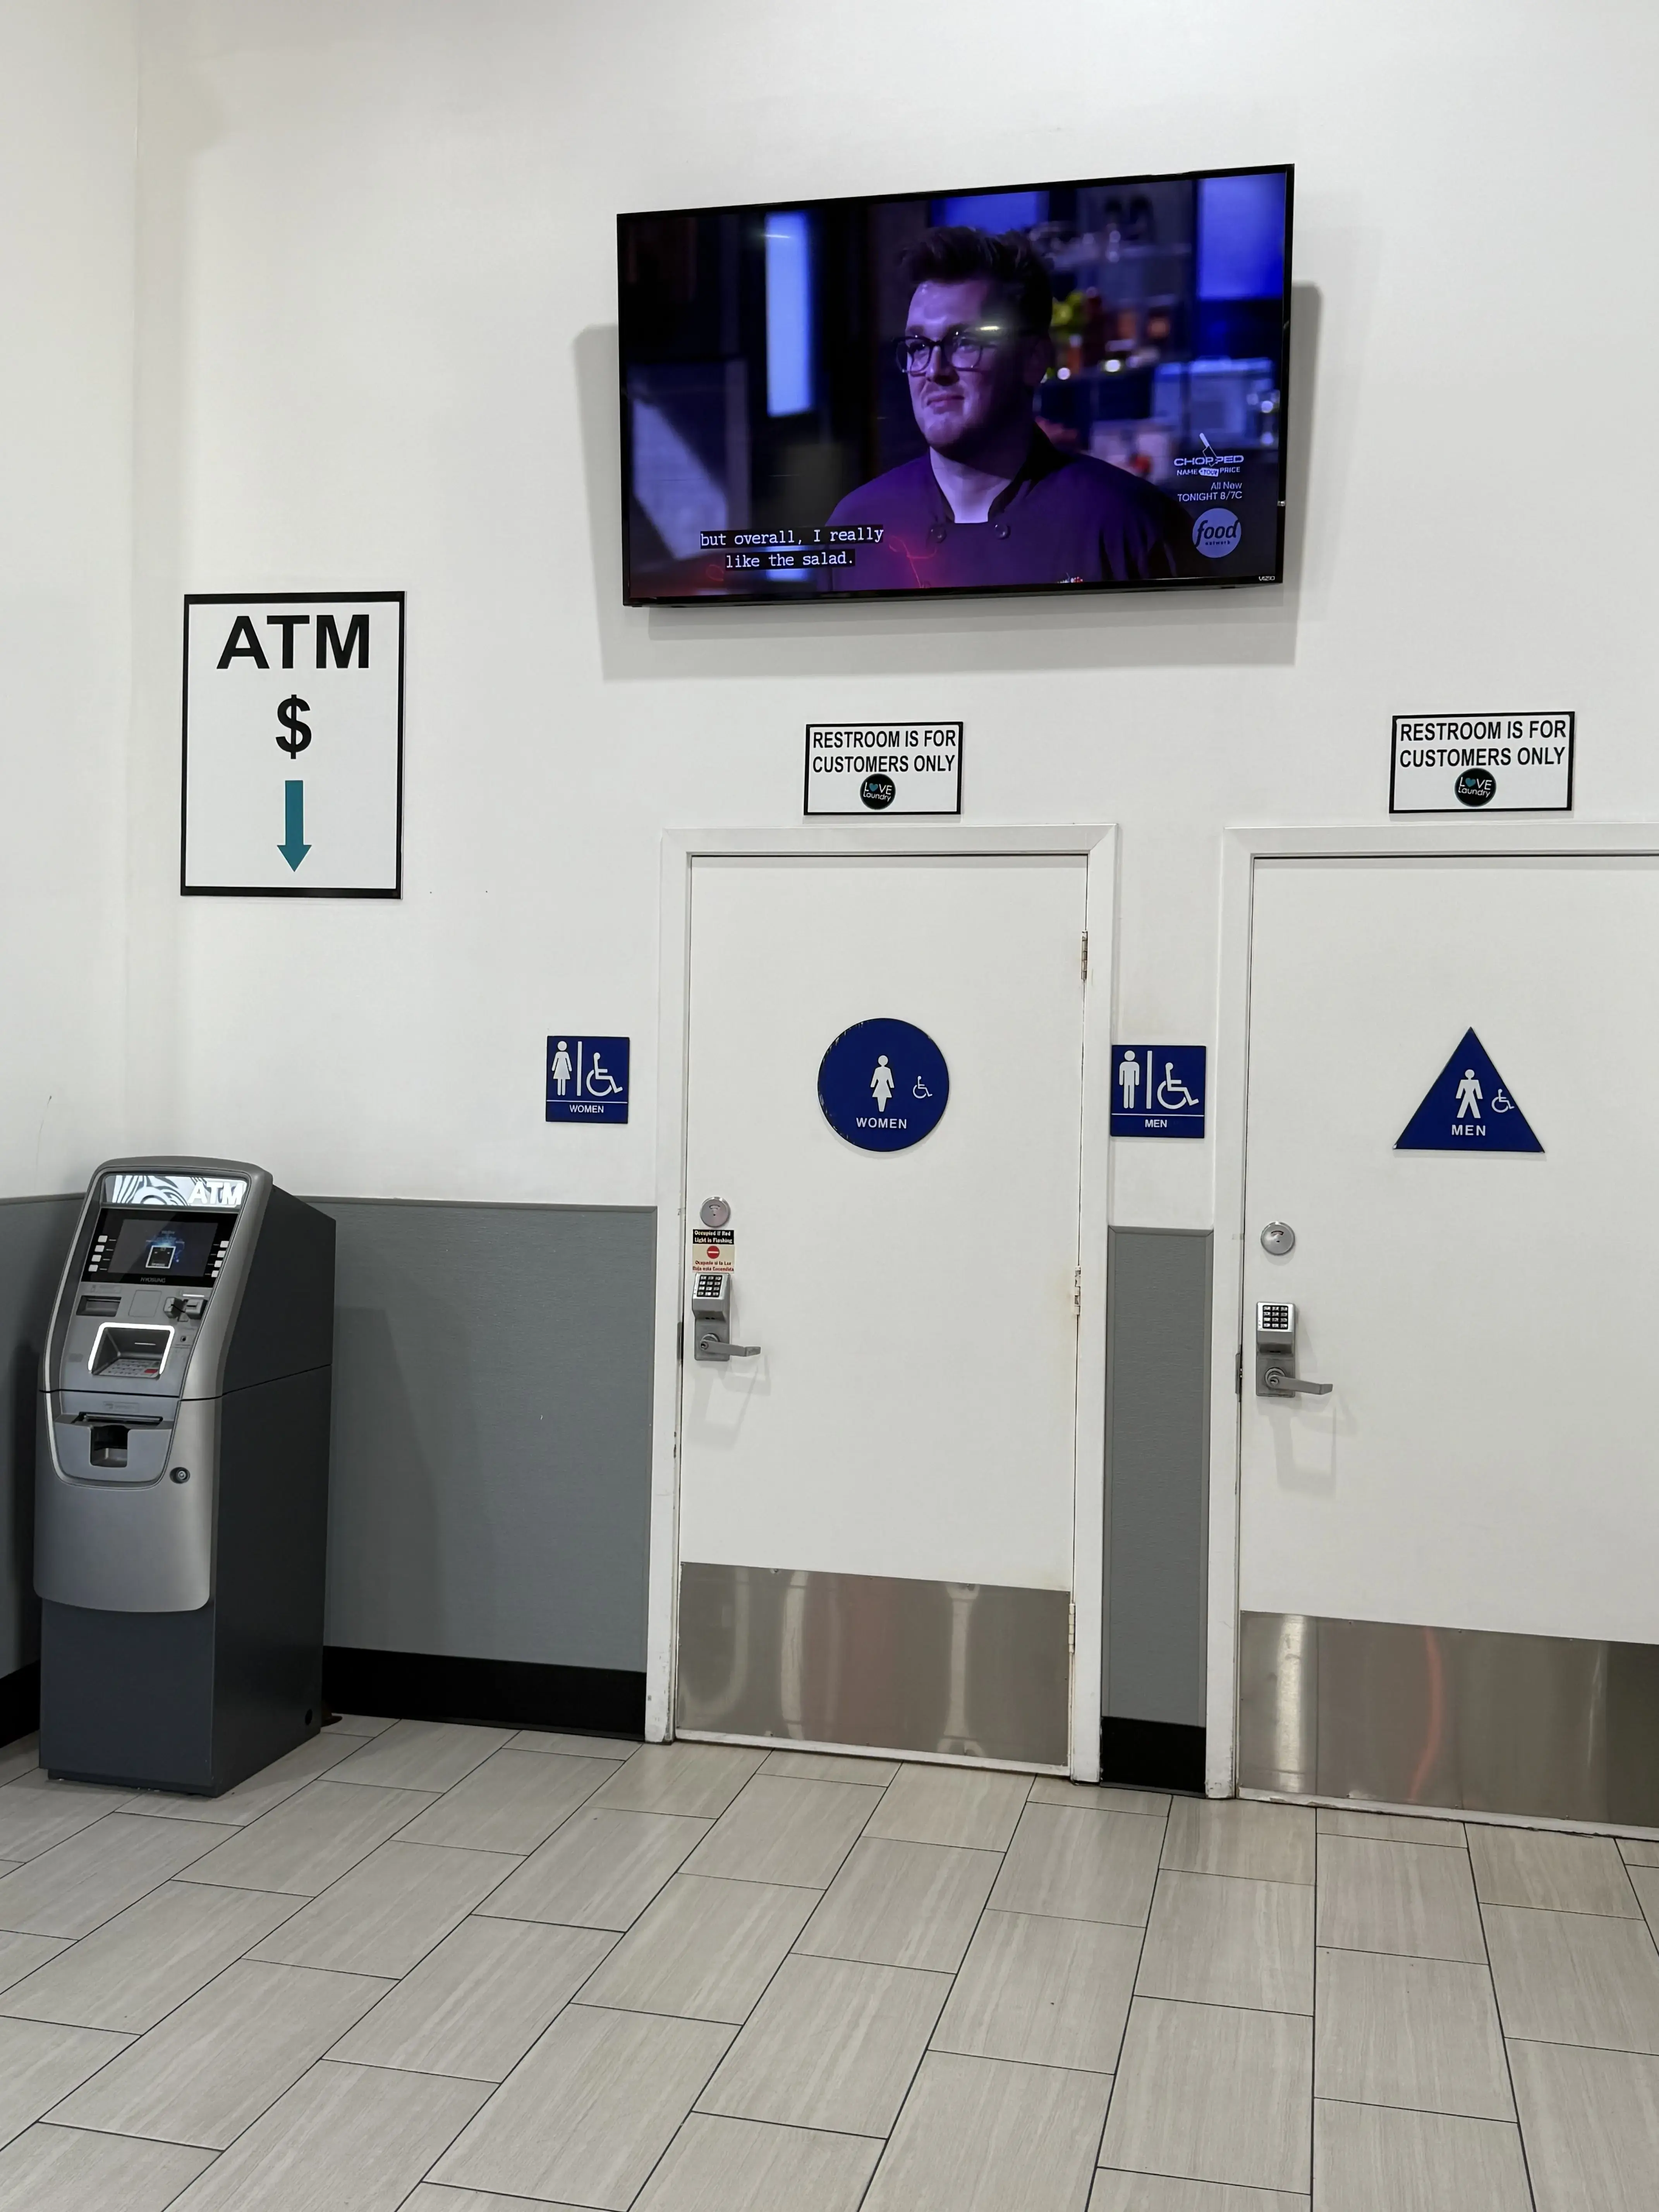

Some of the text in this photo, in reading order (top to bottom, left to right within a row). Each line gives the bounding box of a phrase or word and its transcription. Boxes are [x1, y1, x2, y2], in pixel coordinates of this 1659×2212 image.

[1174, 455, 1244, 466] CHOPPED
[1211, 481, 1221, 490] All
[1177, 491, 1243, 502] TONIGHT 8/7C
[701, 527, 884, 546] but overall, I really
[1195, 520, 1240, 548] food
[726, 551, 853, 568] like the salad.
[216, 614, 369, 670] ATM
[275, 694, 312, 759] $
[1401, 720, 1566, 741] RESTROOM IS FOR
[813, 730, 956, 748] RESTROOM IS FOR
[813, 754, 955, 773] CUSTOMERS ONLY
[1400, 746, 1566, 768] CUSTOMERS ONLY
[863, 790, 891, 802] Laundry
[1458, 786, 1491, 798] Laundry
[569, 1104, 604, 1113] WOMEN
[856, 1117, 907, 1129] WOMEN
[1145, 1119, 1168, 1128] MEN
[1451, 1124, 1486, 1136] MEN
[188, 1181, 243, 1206] ATM
